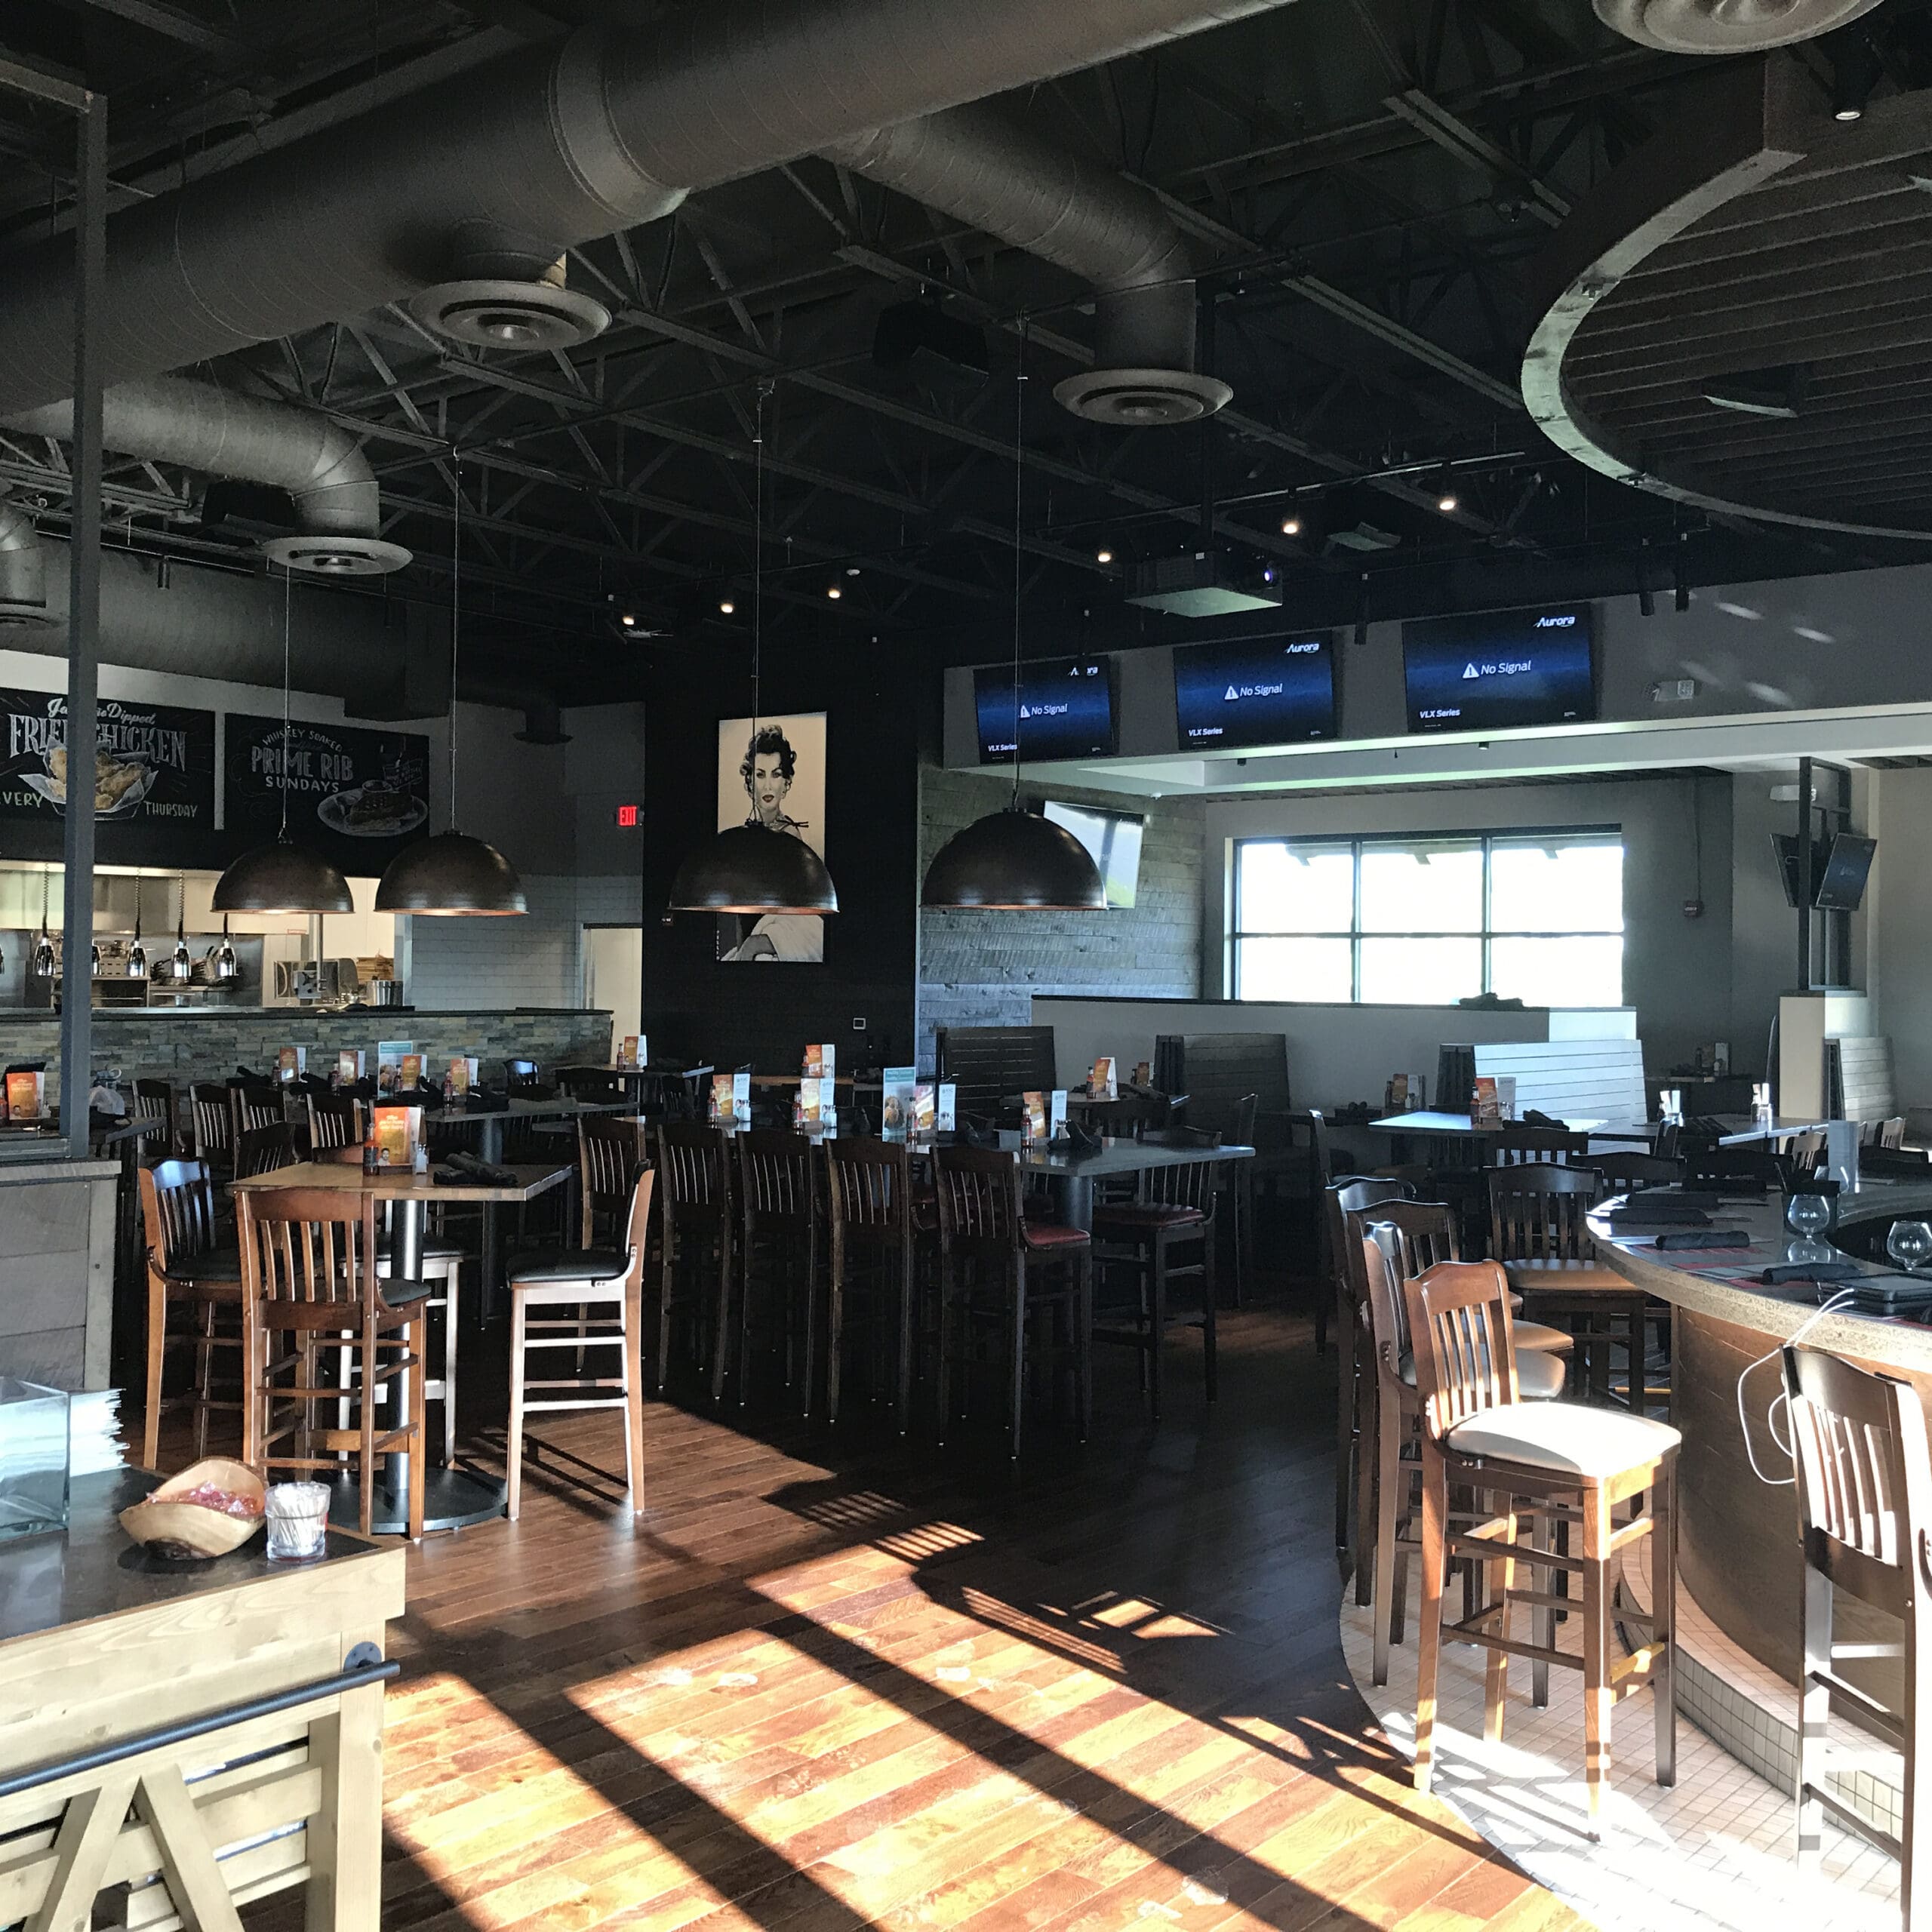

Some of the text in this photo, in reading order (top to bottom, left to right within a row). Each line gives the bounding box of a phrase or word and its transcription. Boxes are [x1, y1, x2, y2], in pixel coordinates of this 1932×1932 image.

[1534, 616, 1576, 628] Aurora
[1284, 643, 1320, 654] Aurora
[1481, 660, 1531, 675] No Signal
[1240, 683, 1283, 697] No Signal
[106, 703, 156, 725] Dipped
[1031, 703, 1068, 715] No Signal
[1419, 709, 1461, 718] VLX Series
[8, 713, 67, 758] FRIE
[1203, 728, 1223, 736] Series
[261, 728, 343, 752] WHISKEY SOAKED
[251, 746, 314, 777] PRIME
[320, 752, 354, 781] RIB
[266, 776, 340, 793] SUNDAYS
[0, 791, 198, 818] VERY THURSDAY
